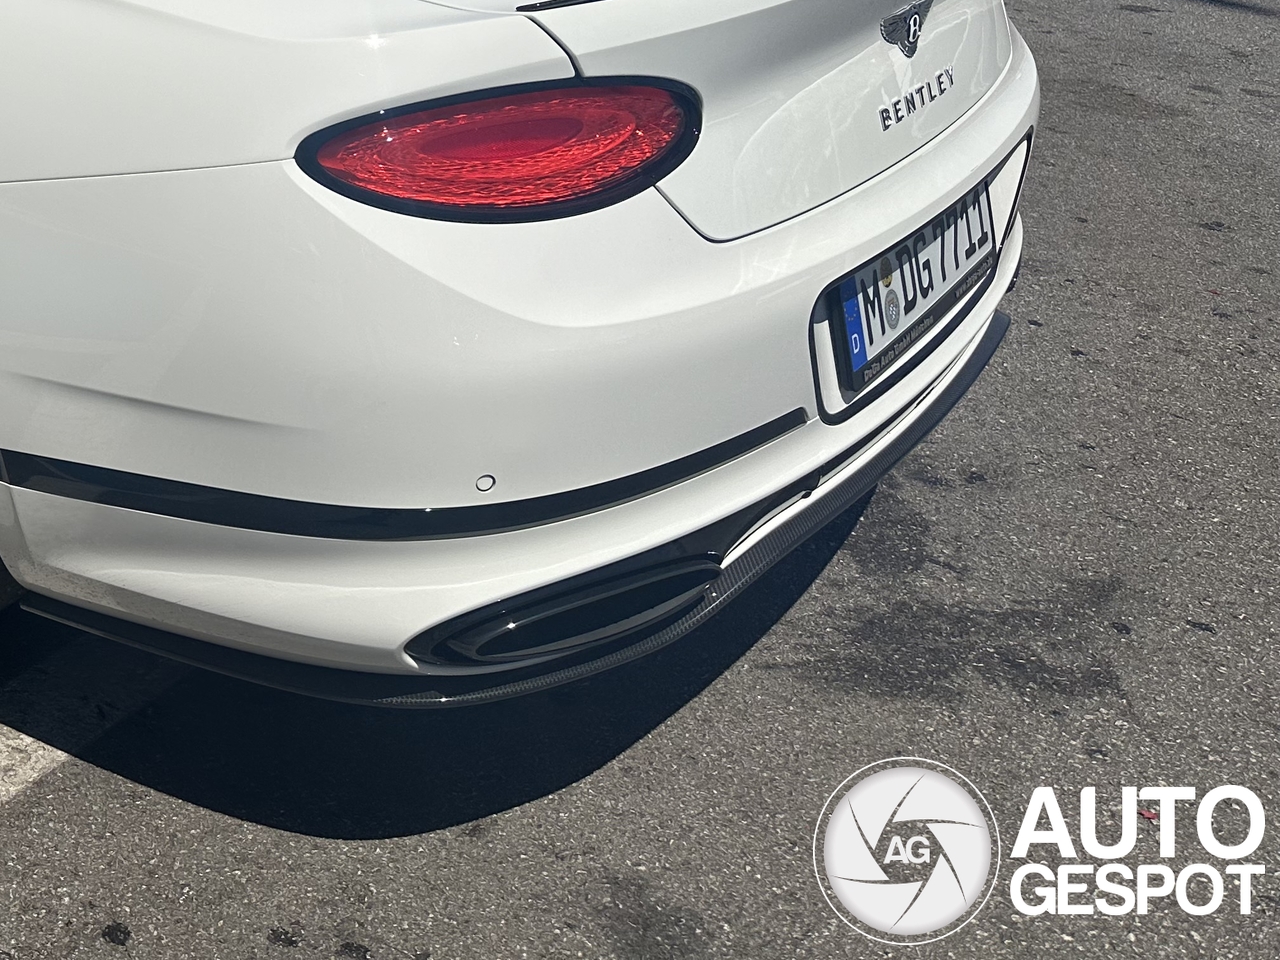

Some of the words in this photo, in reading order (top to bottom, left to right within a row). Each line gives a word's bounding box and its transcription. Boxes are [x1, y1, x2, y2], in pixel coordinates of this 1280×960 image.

[878, 64, 954, 132] BENTLEY
[860, 268, 886, 347] M
[895, 232, 934, 317] DG
[931, 188, 989, 284] 7711
[851, 333, 860, 354] D
